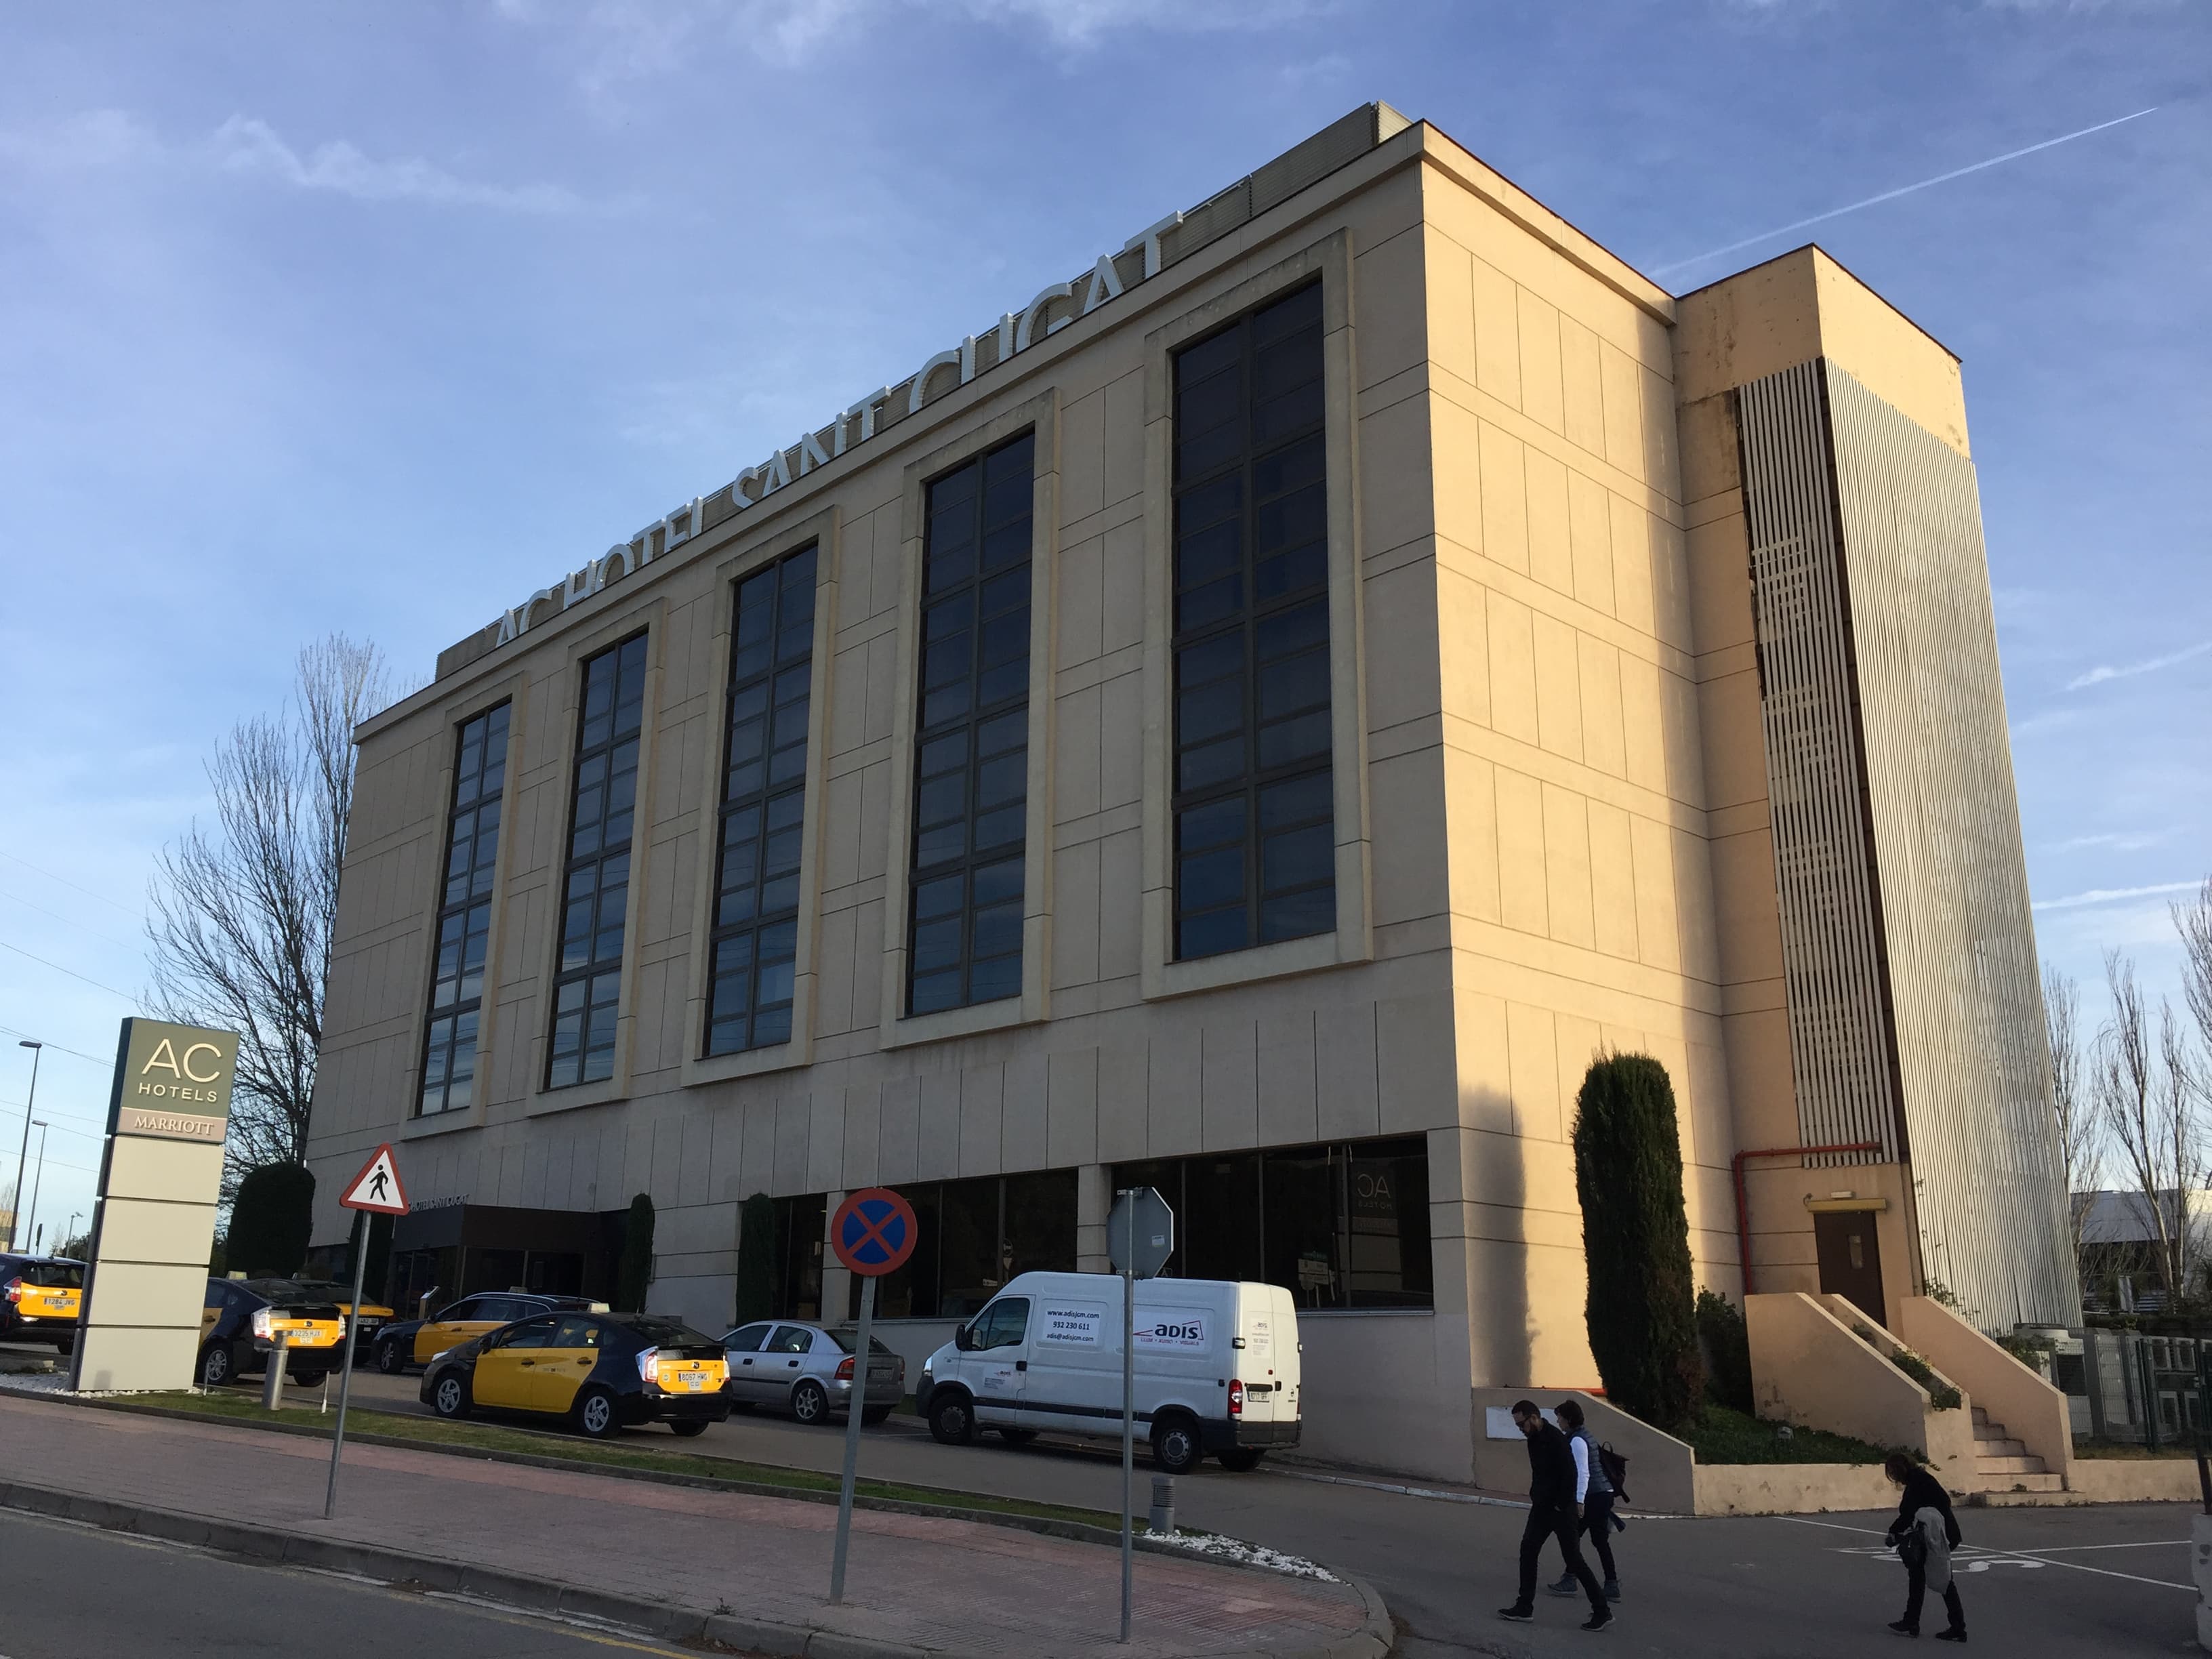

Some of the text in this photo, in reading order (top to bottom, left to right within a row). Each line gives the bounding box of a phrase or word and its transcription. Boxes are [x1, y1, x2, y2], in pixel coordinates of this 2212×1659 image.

[496, 210, 1184, 647] AC HOTEL SANT CUGAT
[142, 1038, 222, 1083] AC
[138, 1082, 218, 1103] HOTELS
[135, 1115, 214, 1135] MARRIOTT
